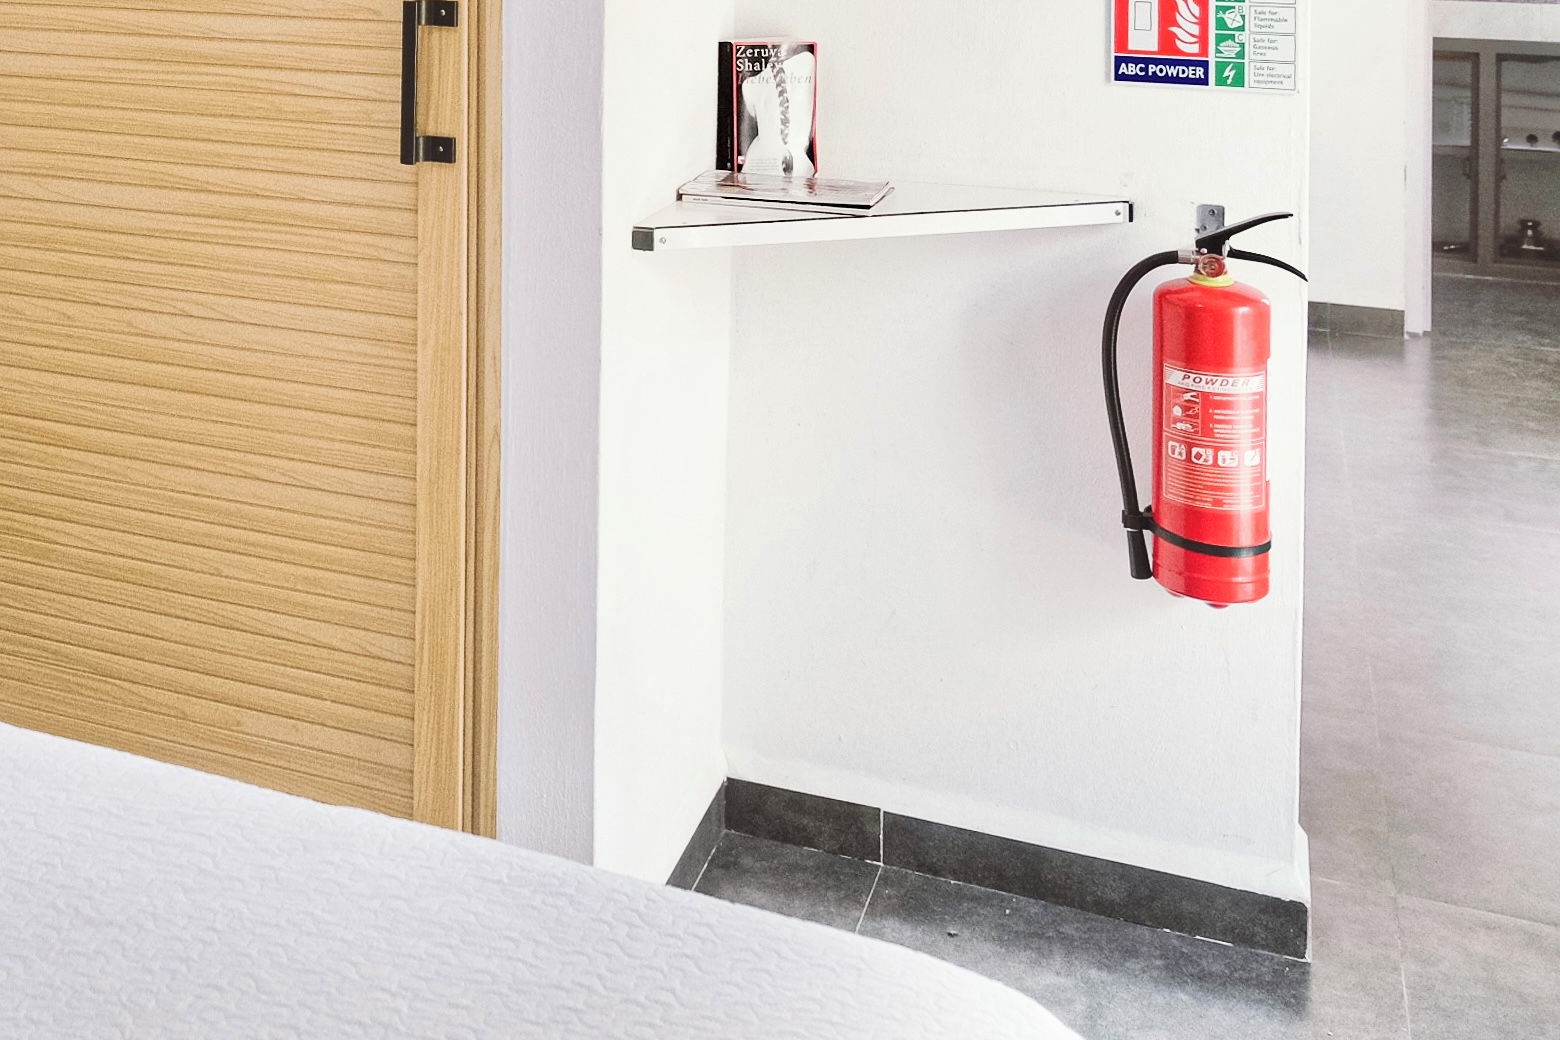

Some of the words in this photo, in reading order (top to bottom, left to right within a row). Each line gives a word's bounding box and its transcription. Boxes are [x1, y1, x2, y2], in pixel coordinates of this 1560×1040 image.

[1237, 33, 1244, 42] C
[736, 45, 784, 60] Zeruya
[1118, 62, 1146, 76] ABC
[1148, 64, 1205, 79] POWDER
[1181, 373, 1251, 387] POWDER
